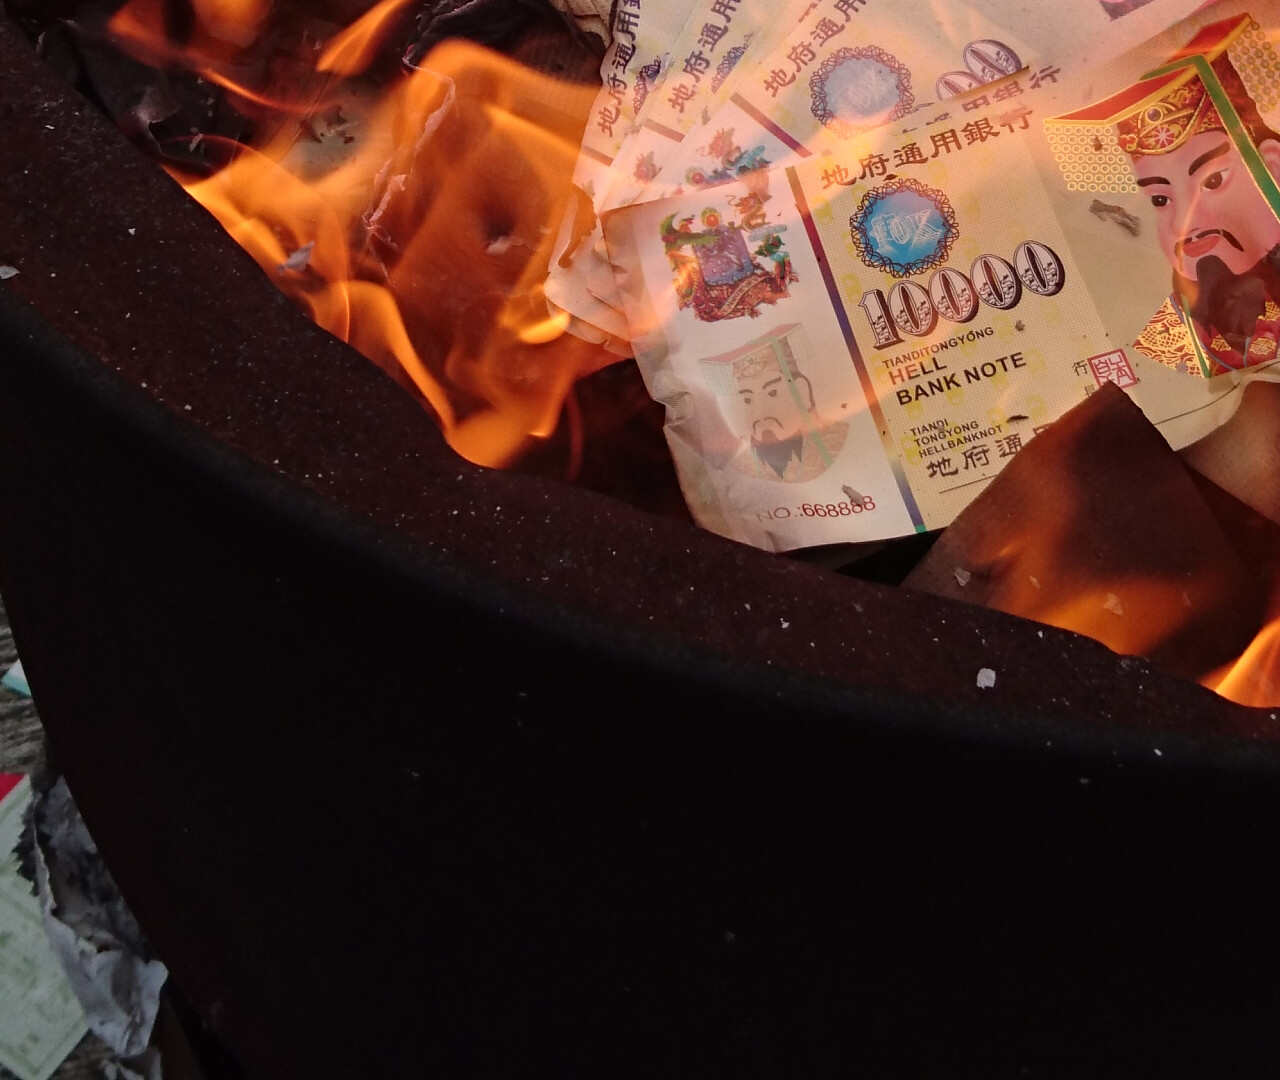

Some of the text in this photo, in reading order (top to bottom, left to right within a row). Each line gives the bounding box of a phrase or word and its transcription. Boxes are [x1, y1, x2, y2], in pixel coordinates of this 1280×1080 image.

[821, 107, 1034, 190] 地府通用銀行
[859, 240, 1065, 350] 10000
[888, 357, 947, 385] HELL
[896, 352, 1027, 406] BANK NOTE
[910, 418, 949, 437] TIANDI
[914, 420, 979, 448] TONGYONG
